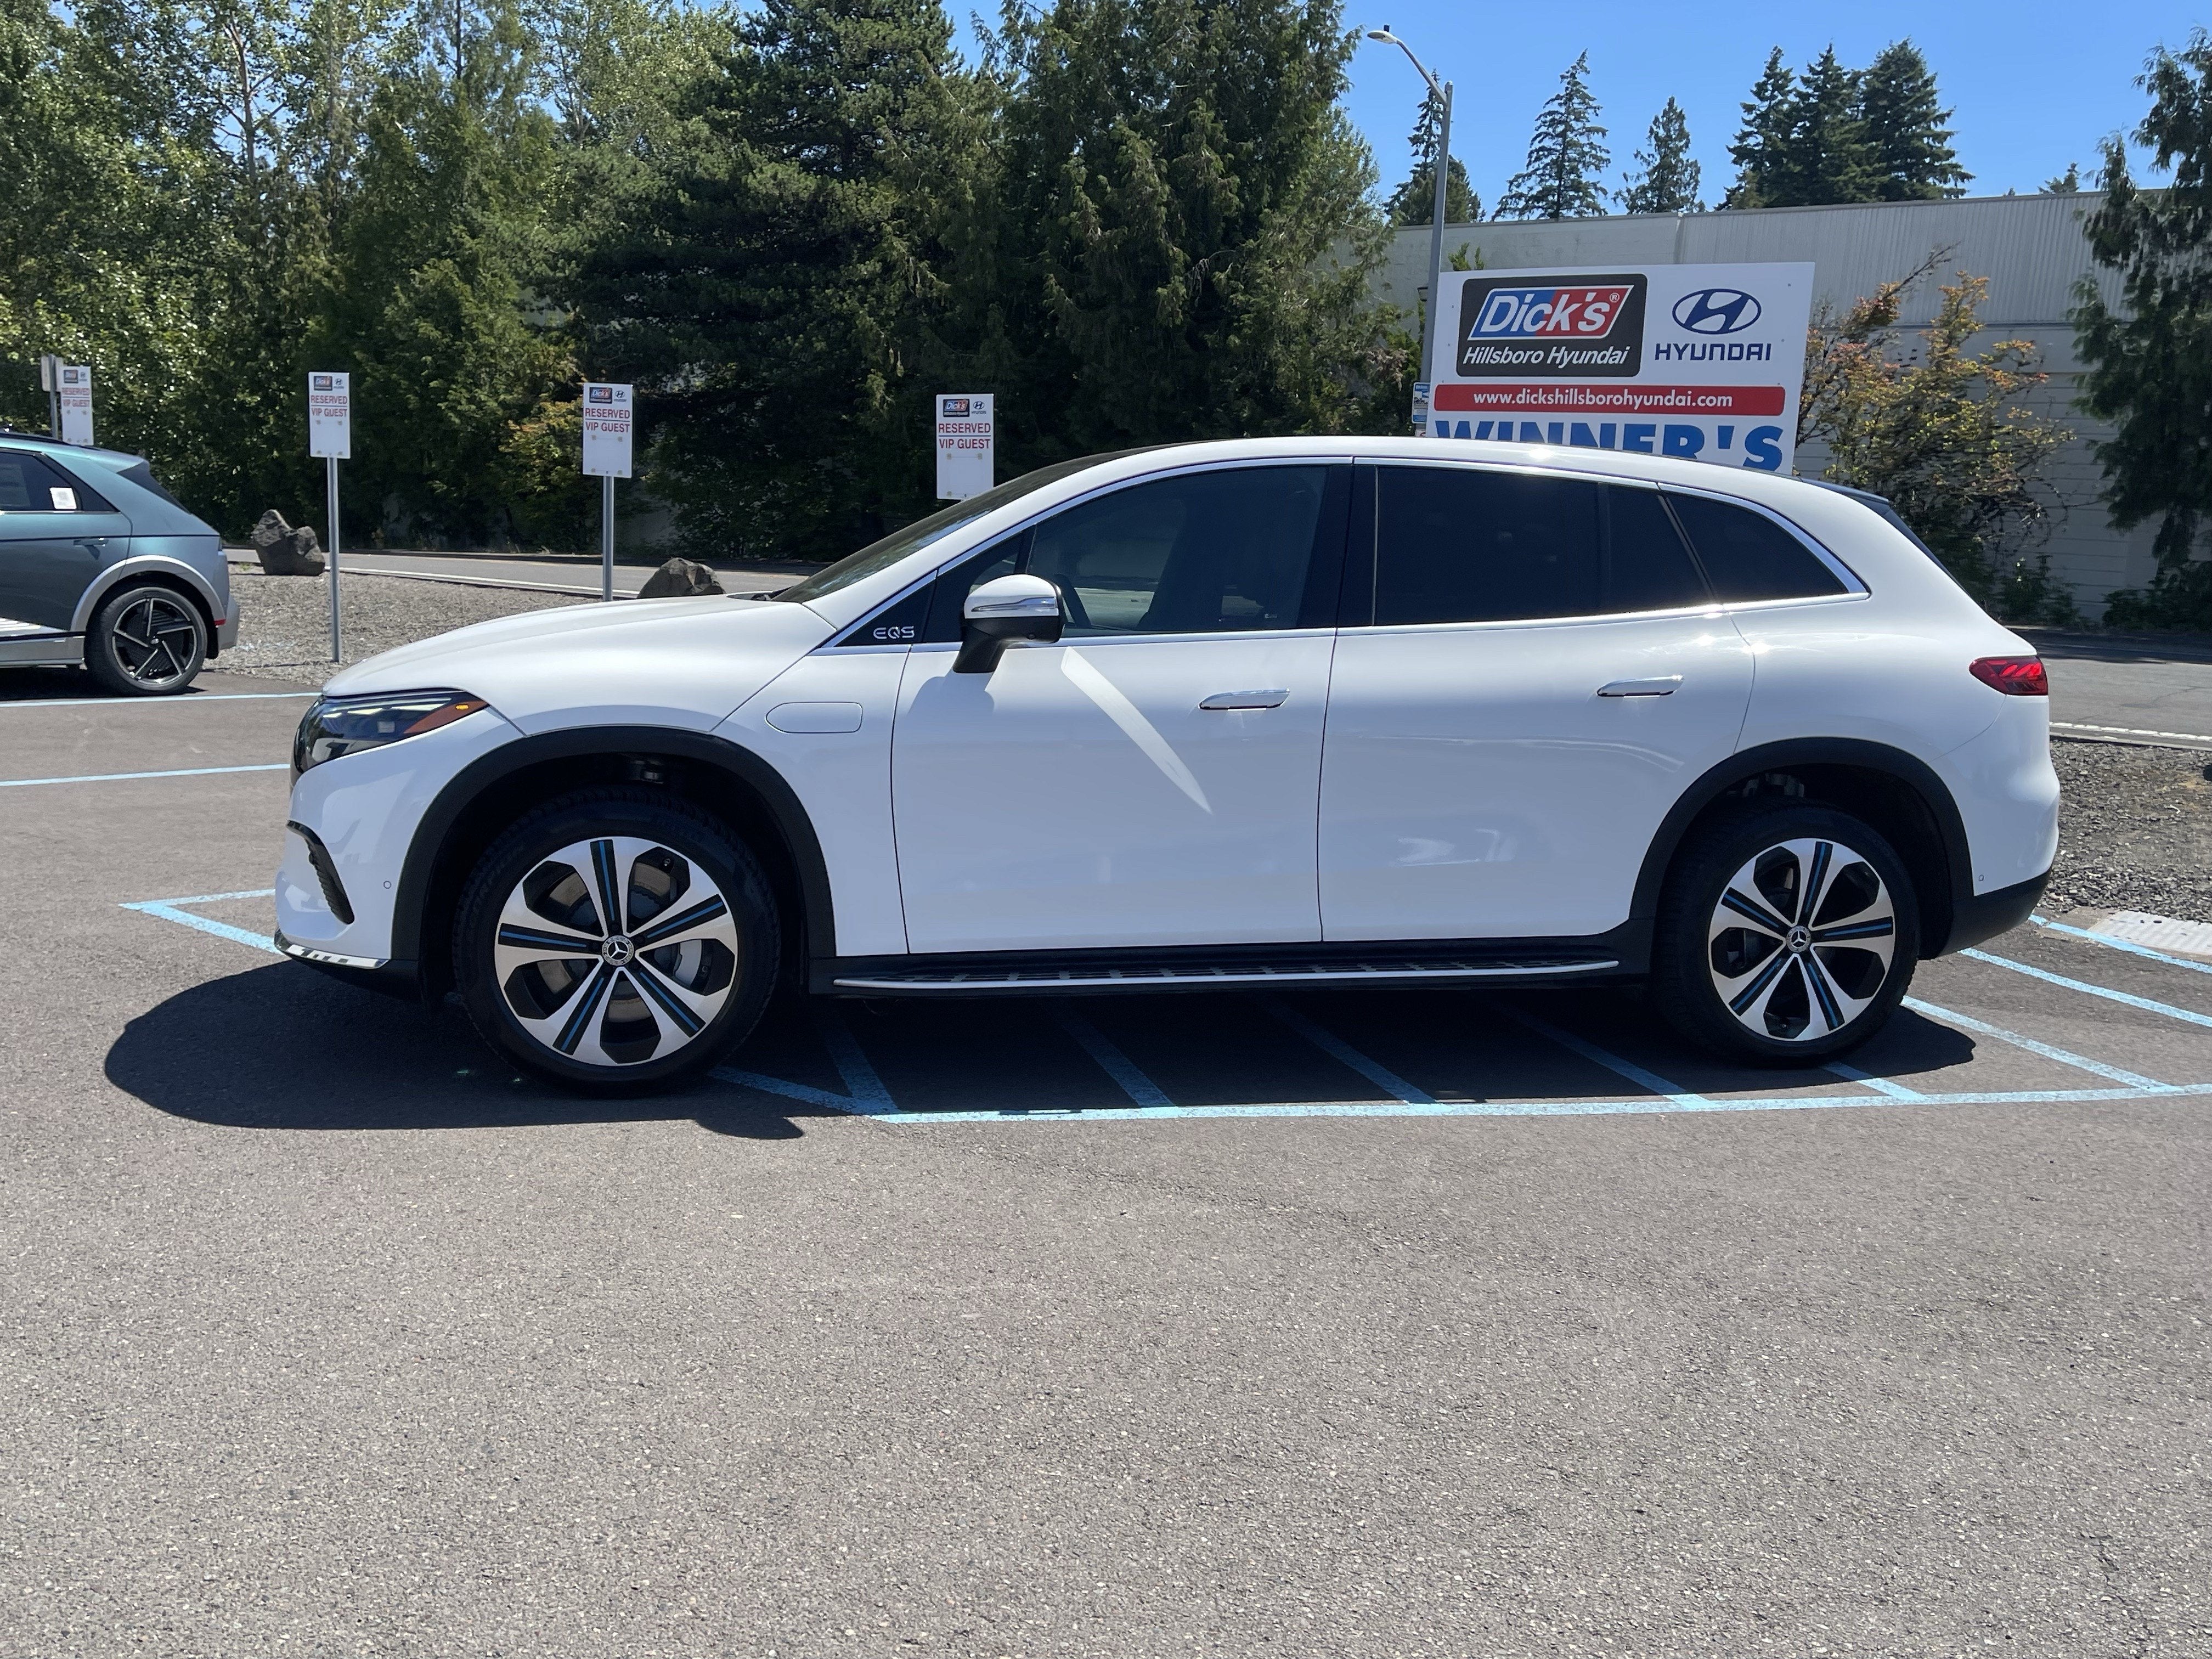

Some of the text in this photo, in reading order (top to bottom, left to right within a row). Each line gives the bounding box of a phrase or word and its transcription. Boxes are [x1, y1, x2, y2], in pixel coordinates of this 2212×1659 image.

[1480, 292, 1610, 332] Dick's
[1463, 346, 1630, 369] Hillsboro Hyundai
[1655, 343, 1771, 360] HYUNDAI
[311, 394, 348, 405] RESERVED
[1474, 387, 1733, 408] www.dickshillsborohyundai.com
[311, 407, 348, 417] VIP GUEST
[585, 408, 630, 419] RESERVED
[585, 421, 630, 433] VIP GUEST
[938, 423, 991, 433] RESERVED
[939, 438, 991, 449] VIP GUEST
[873, 625, 915, 639] EQS
